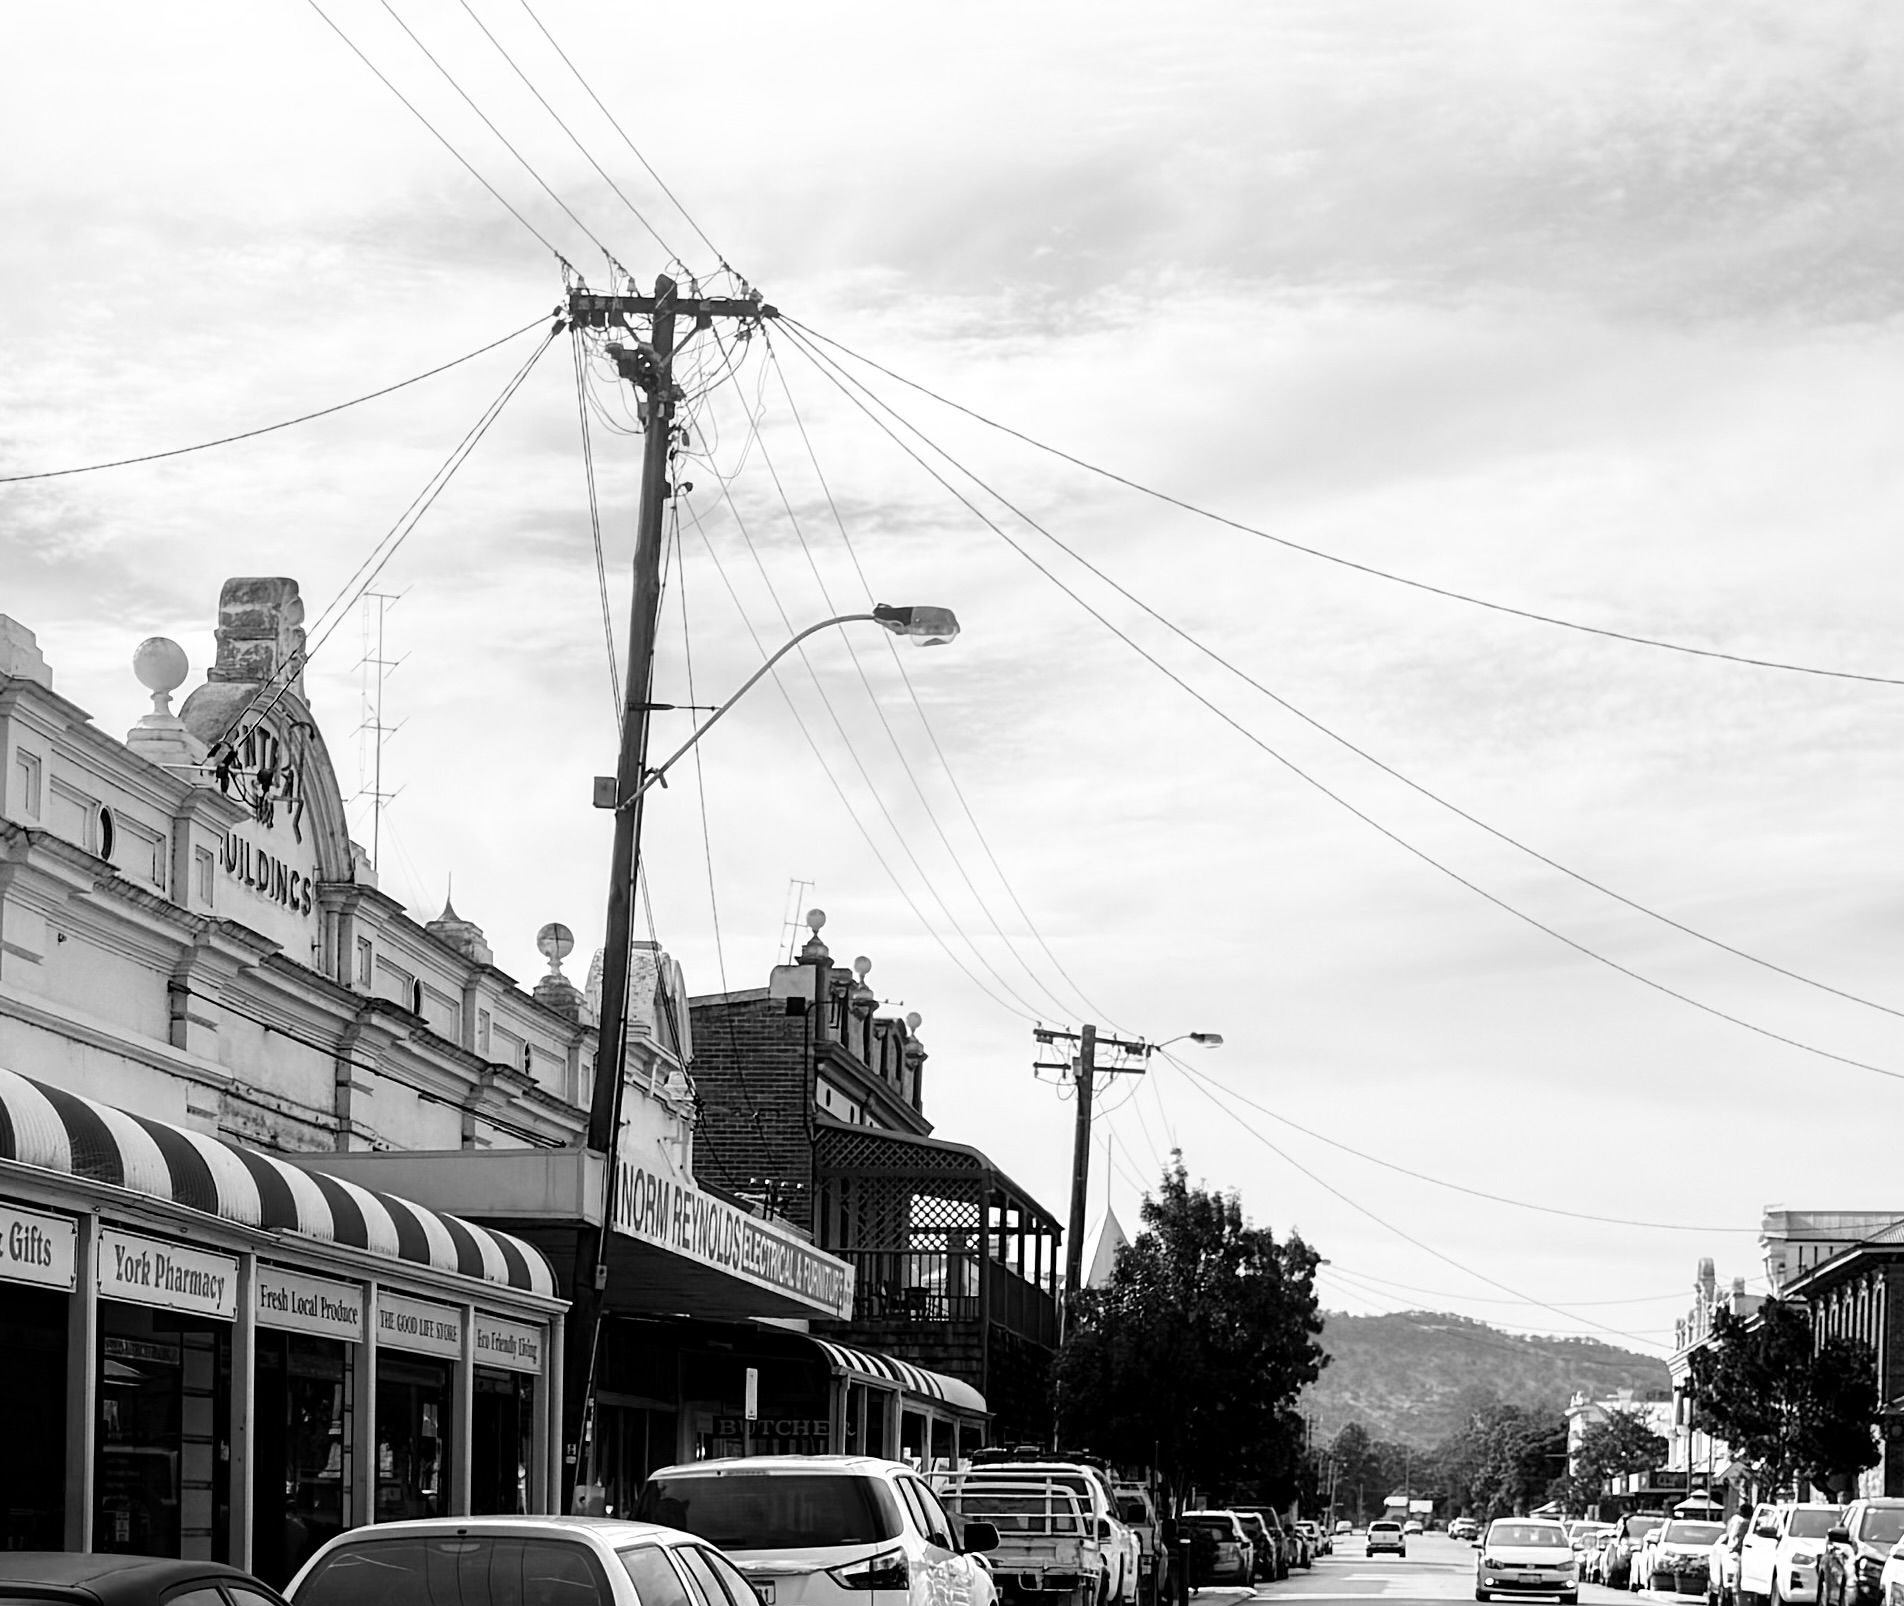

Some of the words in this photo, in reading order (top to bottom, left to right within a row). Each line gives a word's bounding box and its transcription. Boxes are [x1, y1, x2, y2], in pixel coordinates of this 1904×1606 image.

[219, 831, 311, 917] UILDINGS
[9, 1220, 53, 1267] Gifts
[621, 1162, 669, 1242] NORM
[673, 1185, 745, 1272] REYNOLDS
[743, 1228, 794, 1287] ELECTRICAL
[115, 1244, 151, 1287] York
[154, 1253, 225, 1309] Pharmacy
[260, 1284, 288, 1311] Fresh
[292, 1291, 318, 1316] Local
[321, 1297, 358, 1325] Produce
[380, 1310, 394, 1330] THE
[397, 1314, 417, 1335] GOOD
[419, 1319, 434, 1338] LIFE
[436, 1322, 457, 1342] STORE
[477, 1329, 490, 1348] Eco
